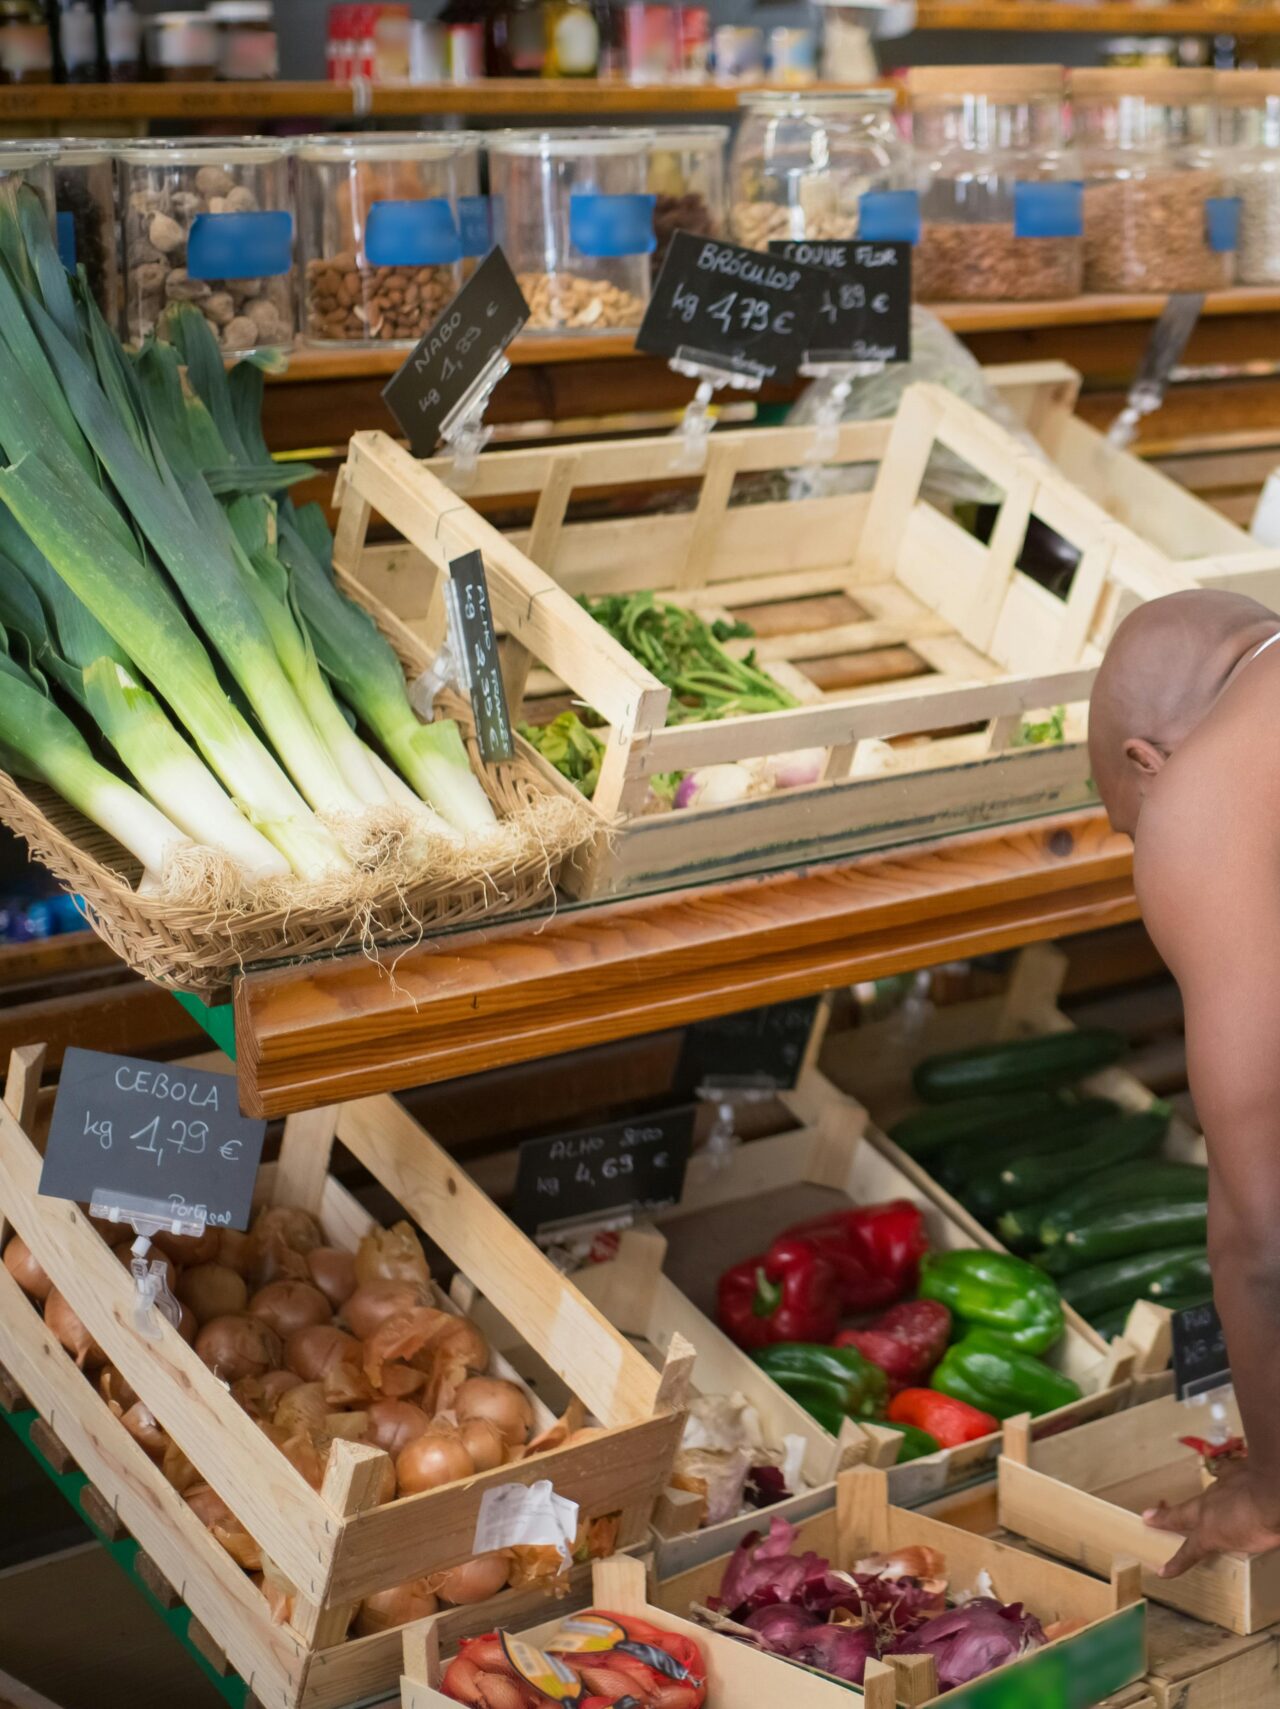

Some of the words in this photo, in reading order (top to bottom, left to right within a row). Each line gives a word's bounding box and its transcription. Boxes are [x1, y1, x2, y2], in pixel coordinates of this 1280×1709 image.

[672, 282, 700, 323] kg
[772, 311, 797, 334] €
[871, 292, 890, 314] €
[414, 311, 462, 374] NABO
[115, 1066, 219, 1112] CEBOLA
[83, 1110, 113, 1150] kg
[129, 1115, 210, 1167] 1,79
[219, 1140, 243, 1161] €
[550, 1135, 605, 1161] ALHO
[167, 1193, 232, 1226] Portugal
